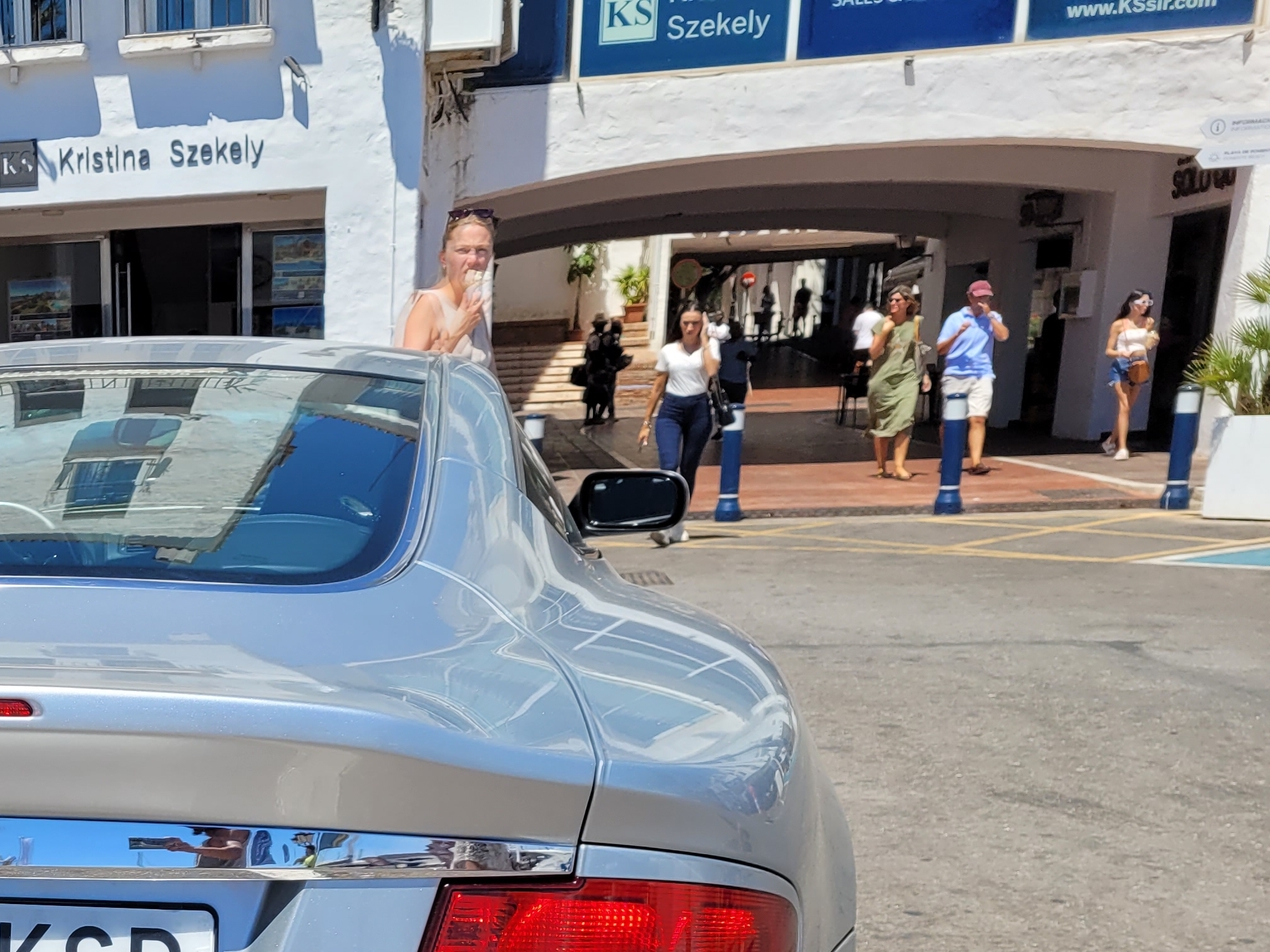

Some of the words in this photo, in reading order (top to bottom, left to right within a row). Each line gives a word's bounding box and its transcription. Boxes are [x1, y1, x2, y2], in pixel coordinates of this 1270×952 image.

[606, 0, 653, 28] KS
[666, 9, 771, 40] Szekely
[58, 145, 151, 176] Kristina
[169, 134, 265, 169] Szekely
